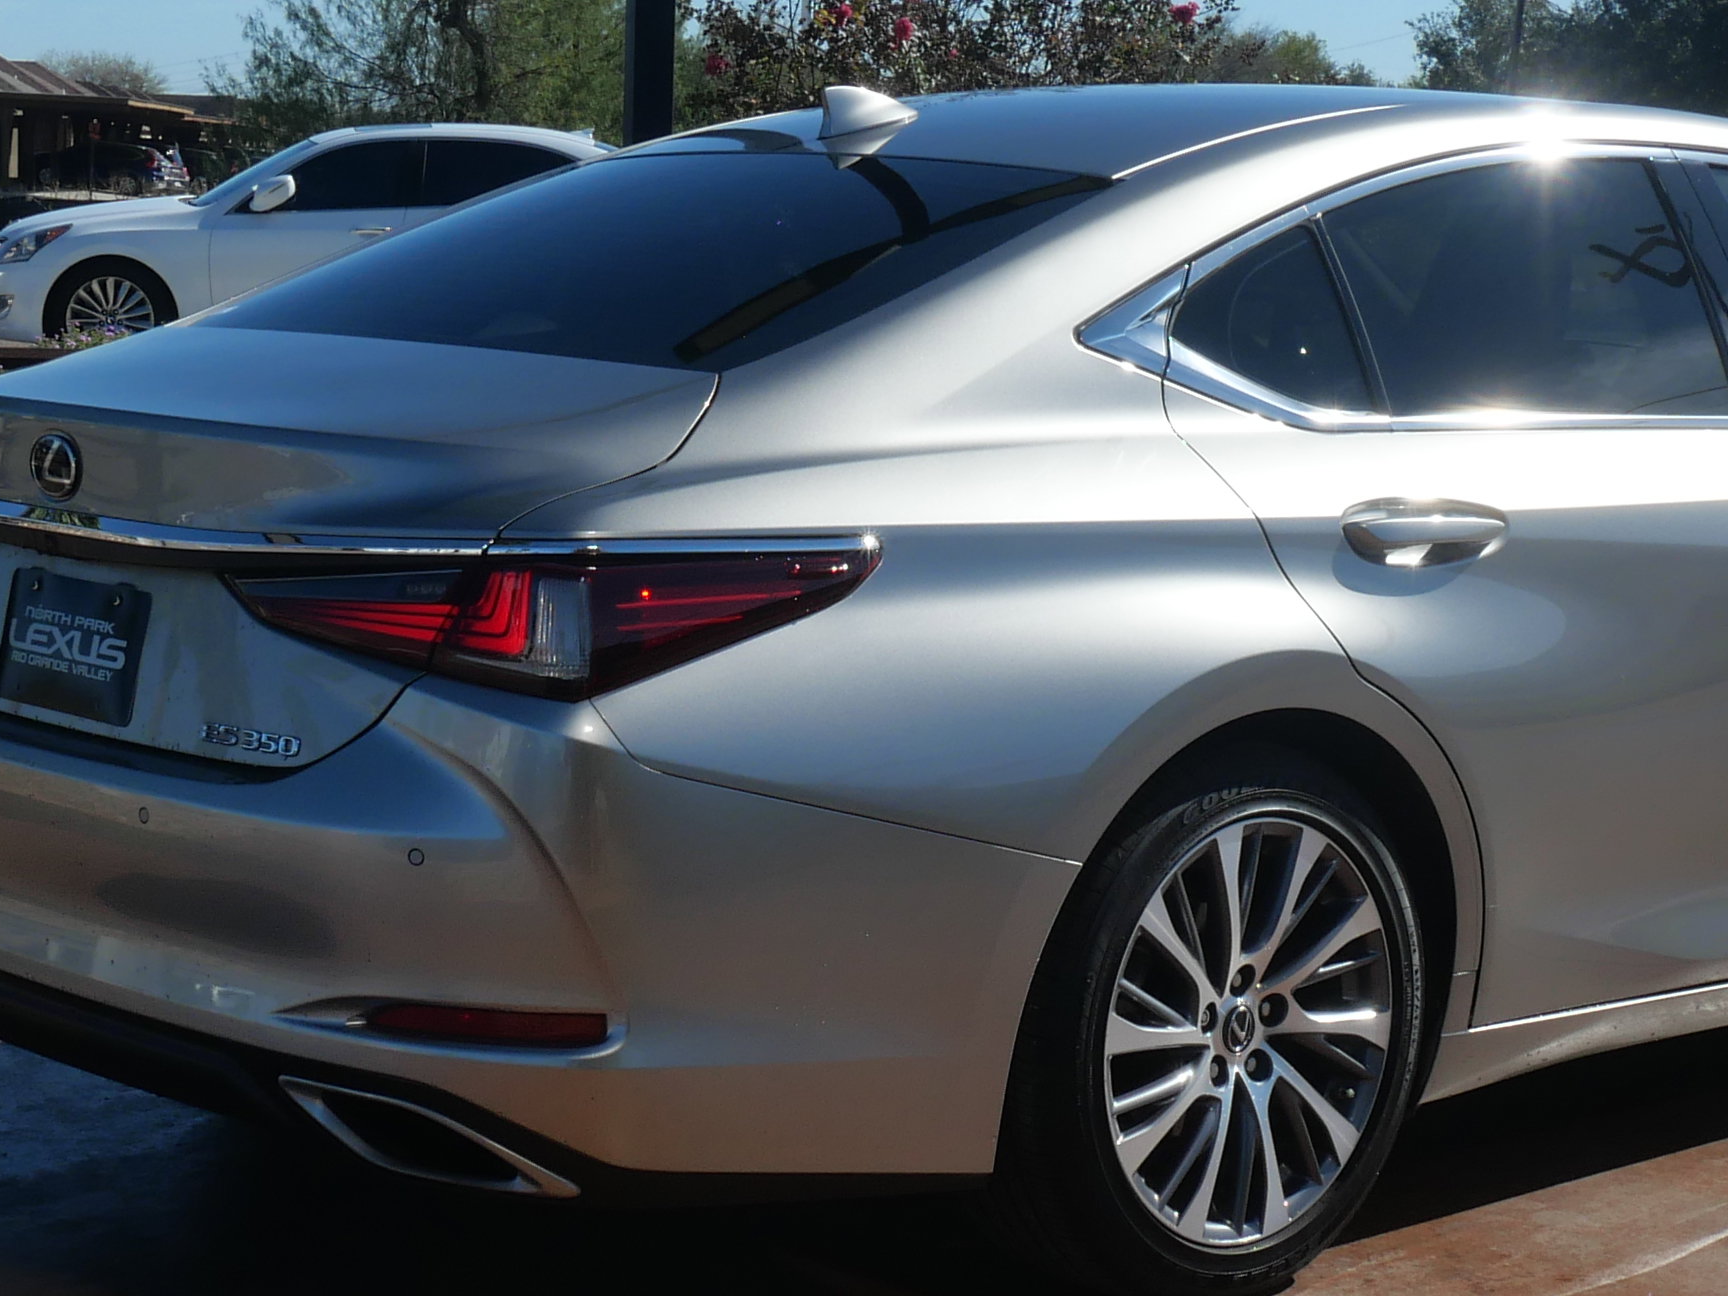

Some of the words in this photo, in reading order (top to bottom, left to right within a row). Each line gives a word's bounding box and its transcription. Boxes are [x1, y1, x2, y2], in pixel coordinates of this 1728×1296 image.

[73, 615, 116, 635] PARK
[9, 618, 128, 670] LEXUS
[10, 650, 28, 664] RIO
[28, 654, 70, 673] GRANDE
[71, 663, 114, 682] VALLEY
[239, 728, 301, 757] 350
